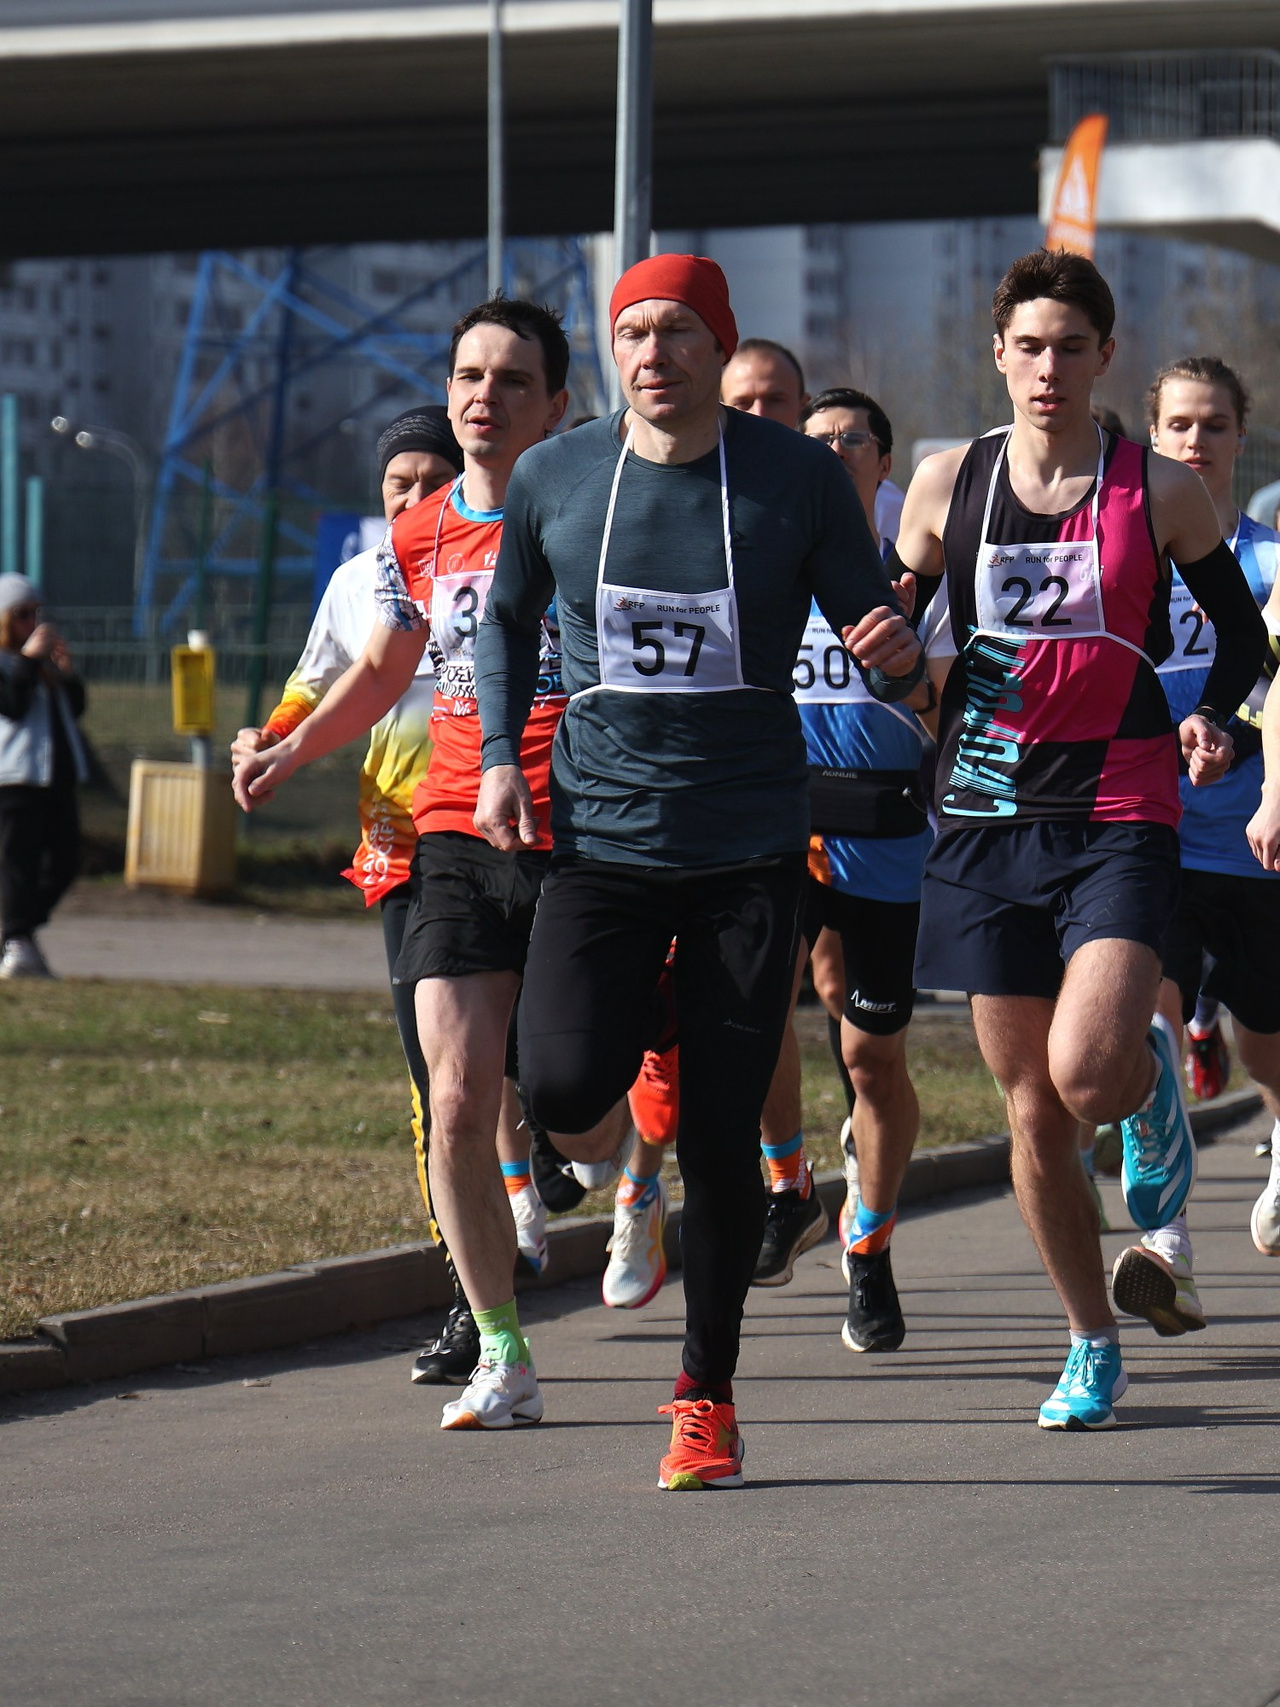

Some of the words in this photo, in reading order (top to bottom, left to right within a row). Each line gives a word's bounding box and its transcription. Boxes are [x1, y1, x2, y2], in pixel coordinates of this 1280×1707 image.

[1000, 556, 1015, 564] RFP
[1025, 556, 1042, 564] RUN
[1043, 555, 1053, 563] for
[1054, 554, 1083, 562] PEOPLE
[628, 600, 645, 610] RFP
[1001, 575, 1073, 627] 22
[657, 604, 674, 613] RUN
[689, 604, 720, 614] PEOPLE
[632, 621, 706, 676] 57
[792, 644, 850, 690] 50
